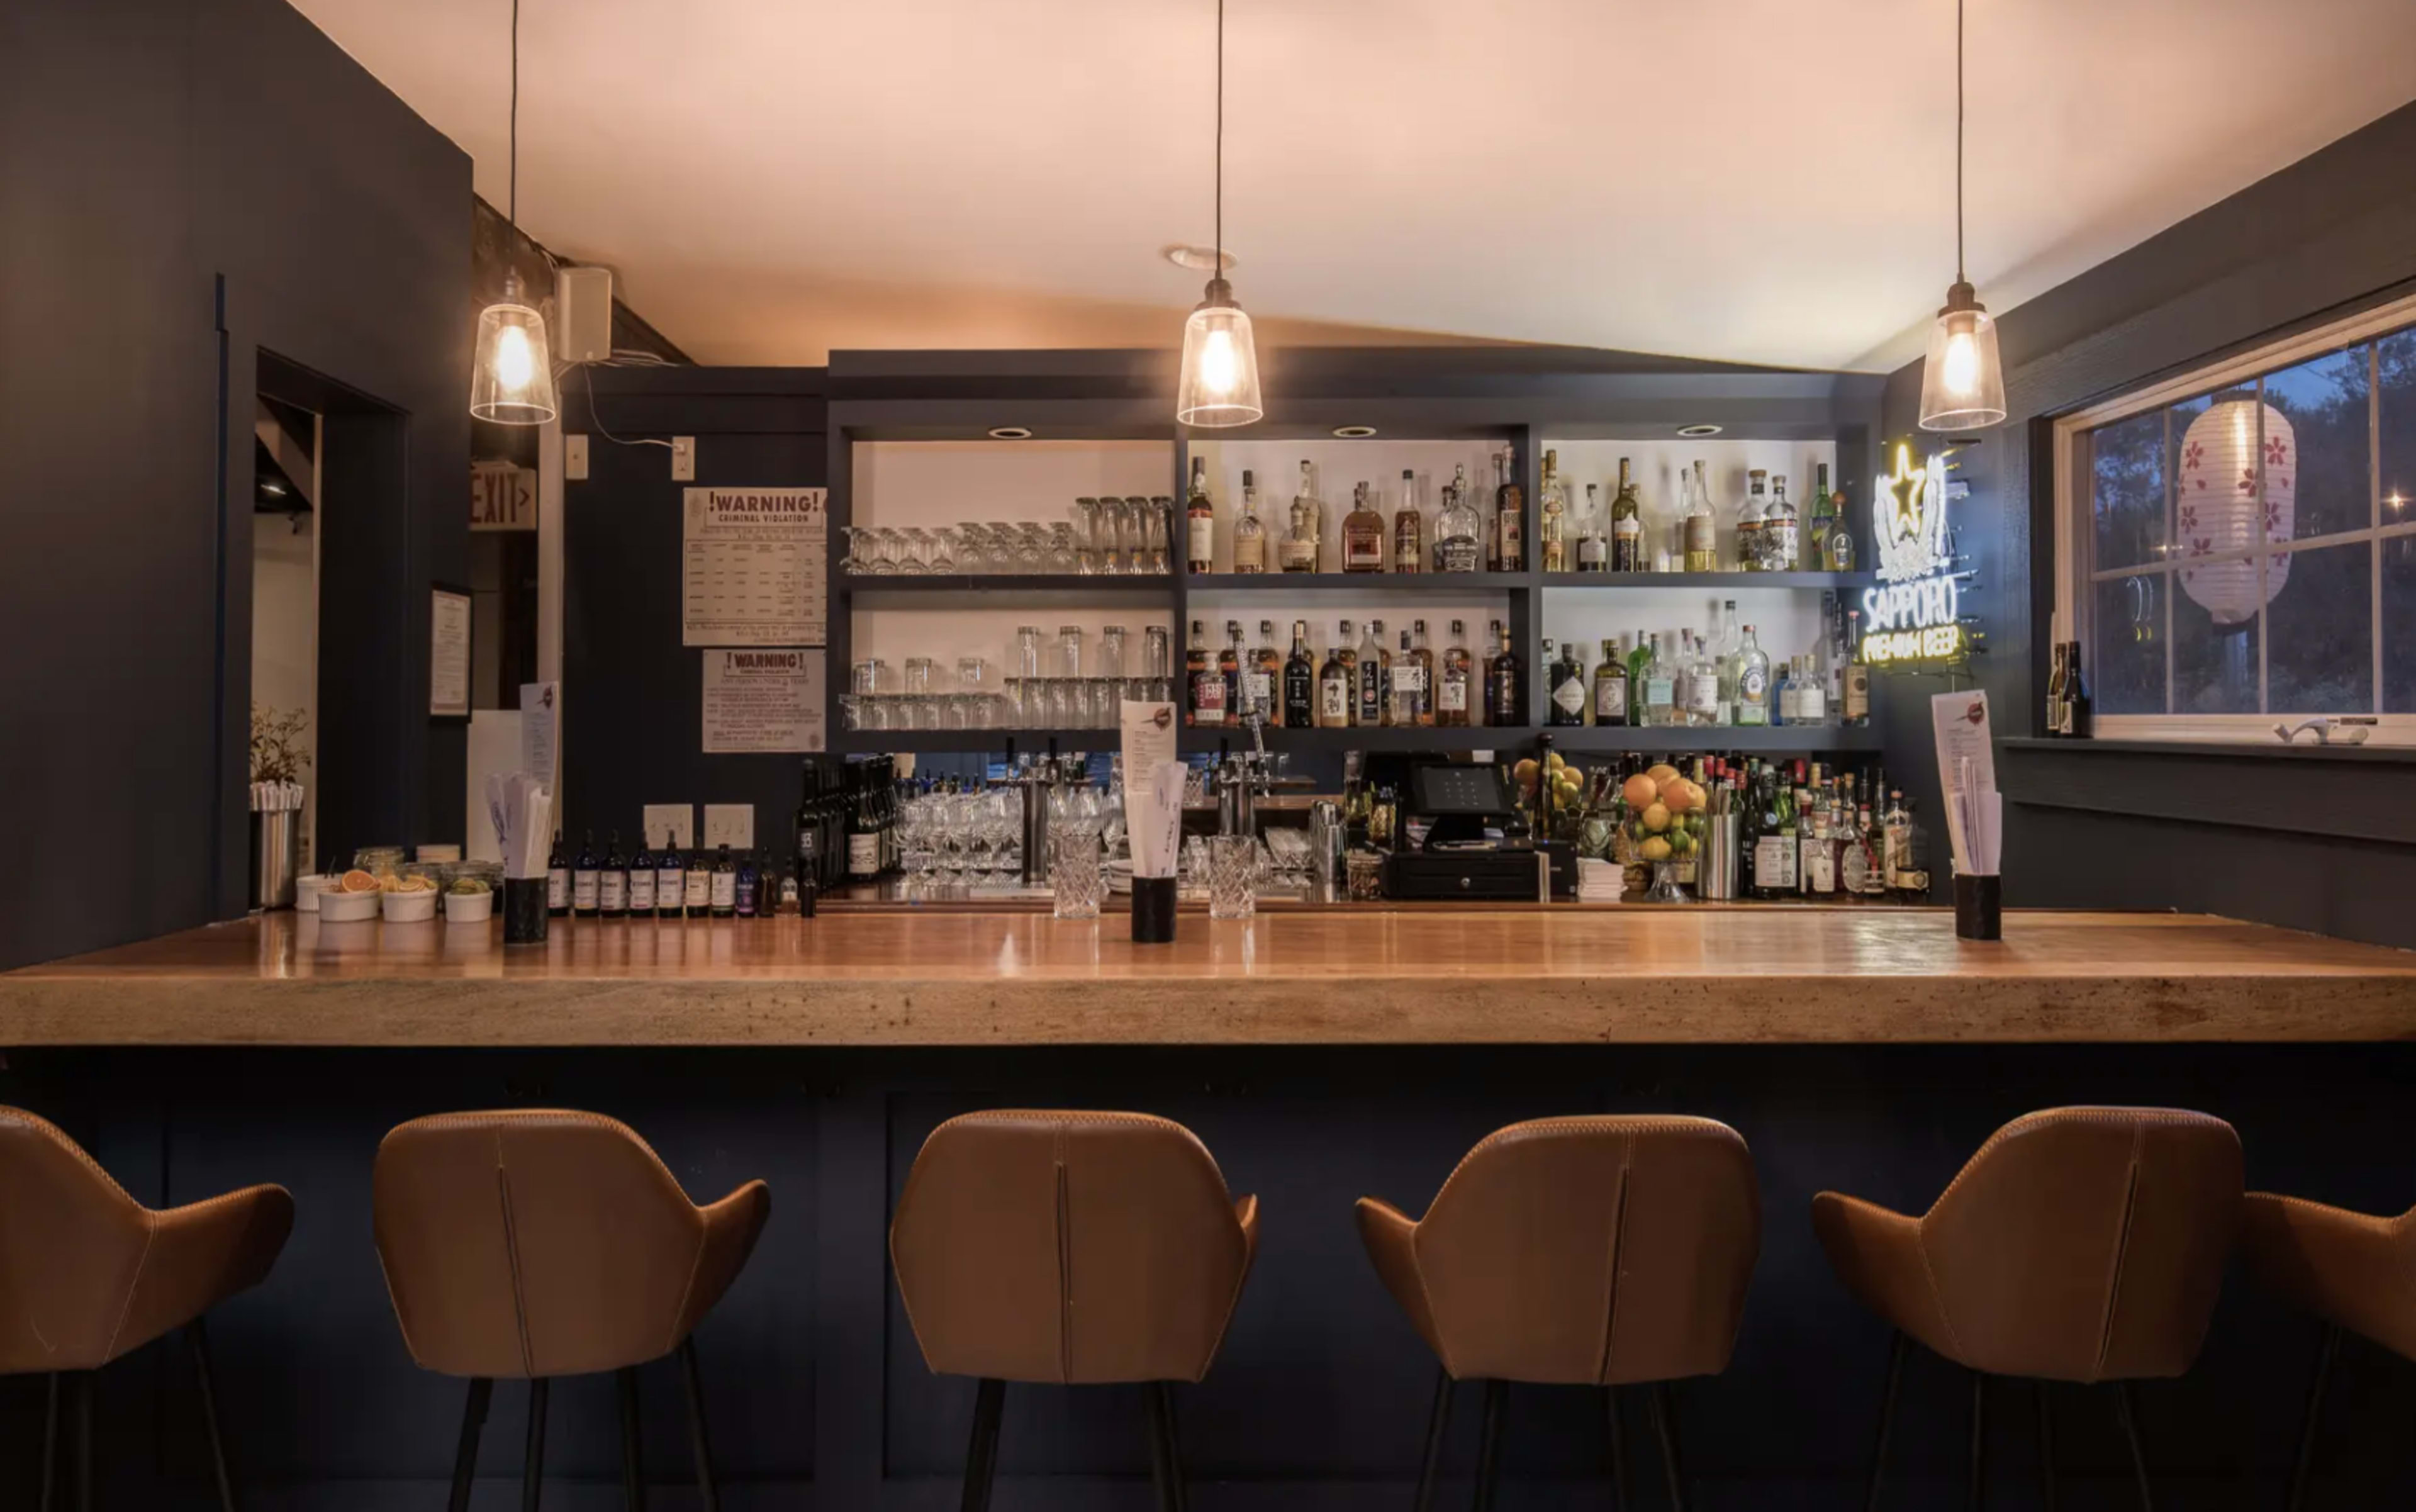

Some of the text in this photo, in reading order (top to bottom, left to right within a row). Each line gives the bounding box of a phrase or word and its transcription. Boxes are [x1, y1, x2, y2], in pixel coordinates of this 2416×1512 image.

[471, 472, 519, 524] EXIT
[719, 514, 808, 523] CRIMINAL VIOLATION
[1862, 576, 1957, 632] SAPPORO
[1862, 625, 1959, 664] PREMIUM BEER
